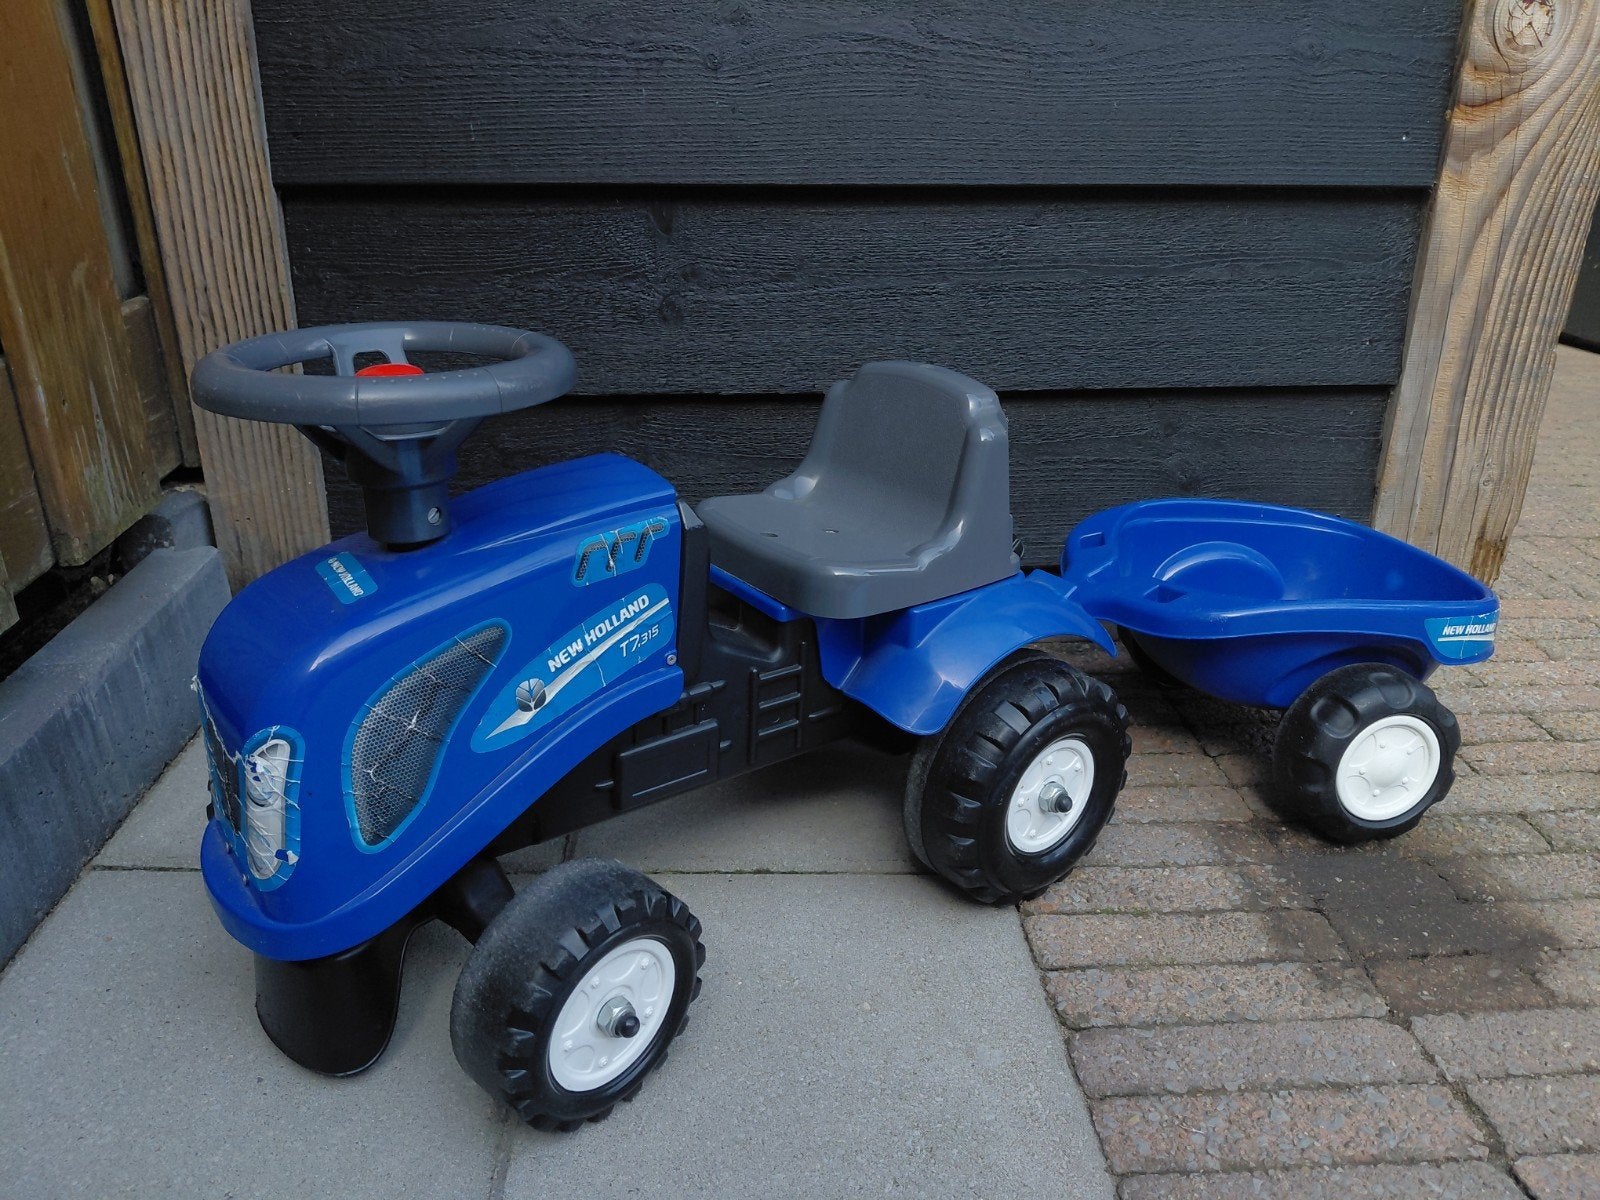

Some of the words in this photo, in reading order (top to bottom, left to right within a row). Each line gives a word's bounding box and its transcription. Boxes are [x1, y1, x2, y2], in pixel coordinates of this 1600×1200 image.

[547, 639, 584, 673] NEW
[584, 594, 650, 646] HOLLAND
[619, 624, 659, 657] T7.315
[1442, 625, 1465, 635] NEW
